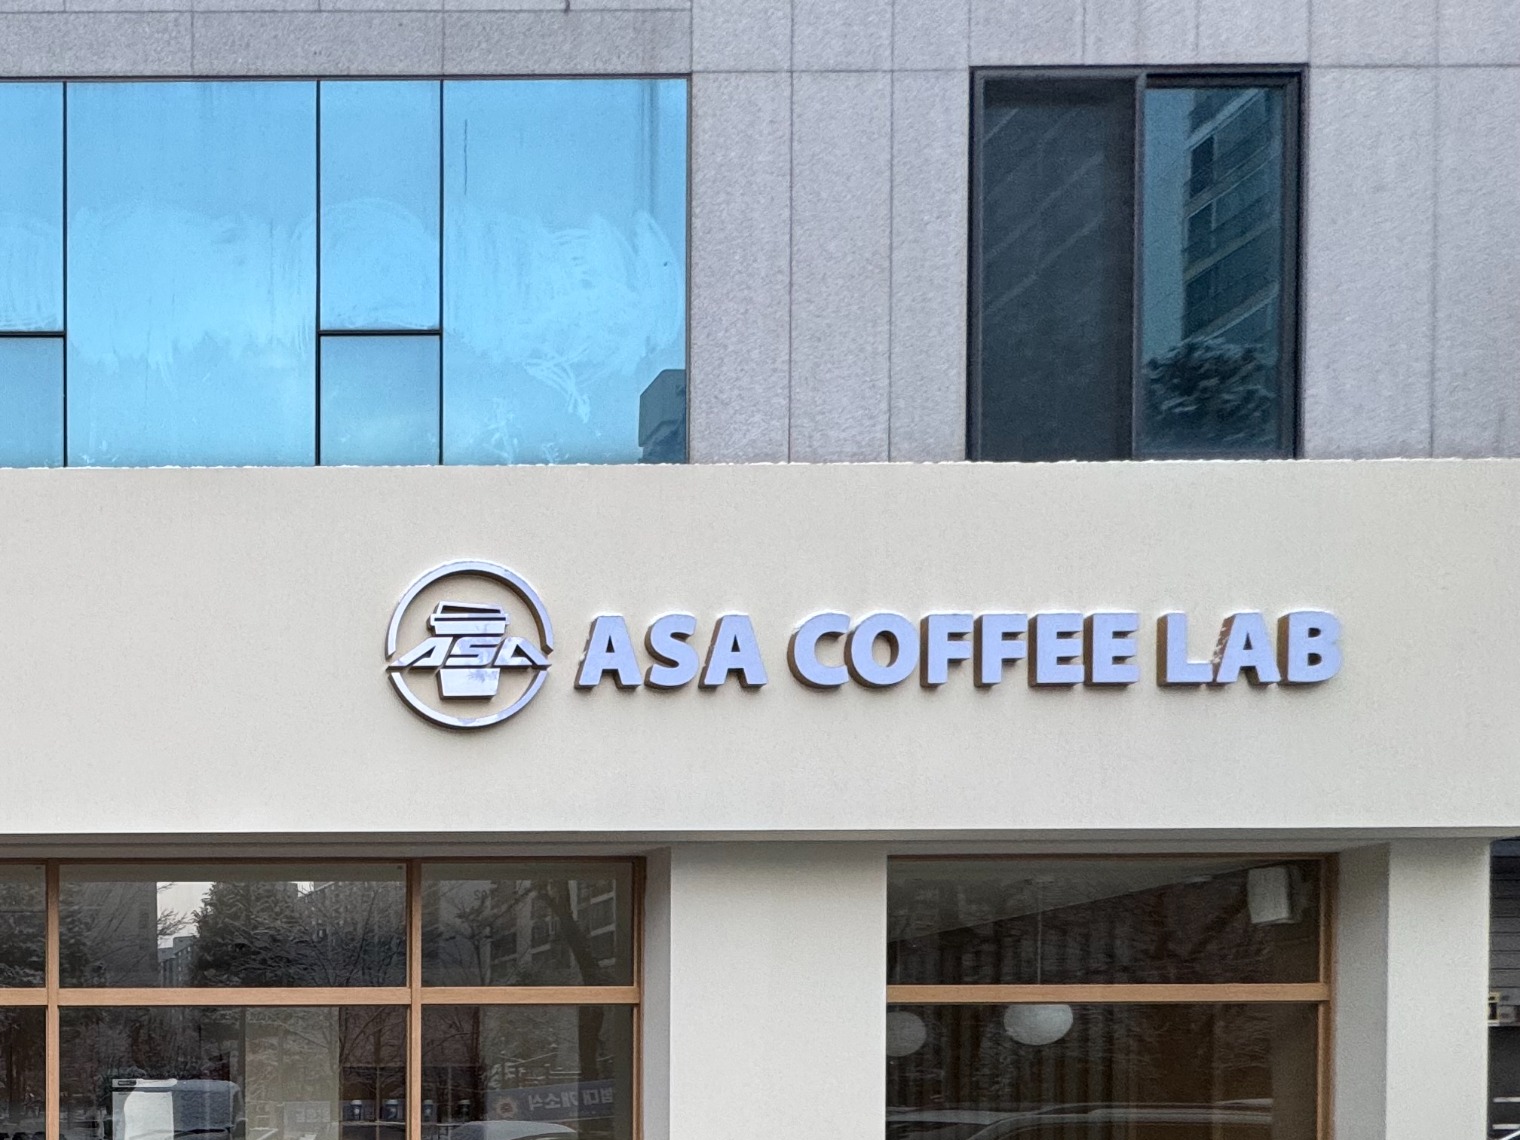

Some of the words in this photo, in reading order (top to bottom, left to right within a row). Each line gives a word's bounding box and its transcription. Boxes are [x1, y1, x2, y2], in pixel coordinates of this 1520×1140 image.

[386, 636, 552, 671] ASA
[574, 610, 768, 690] ASA
[787, 610, 1142, 691] COFFEE
[1156, 609, 1342, 690] LAB
